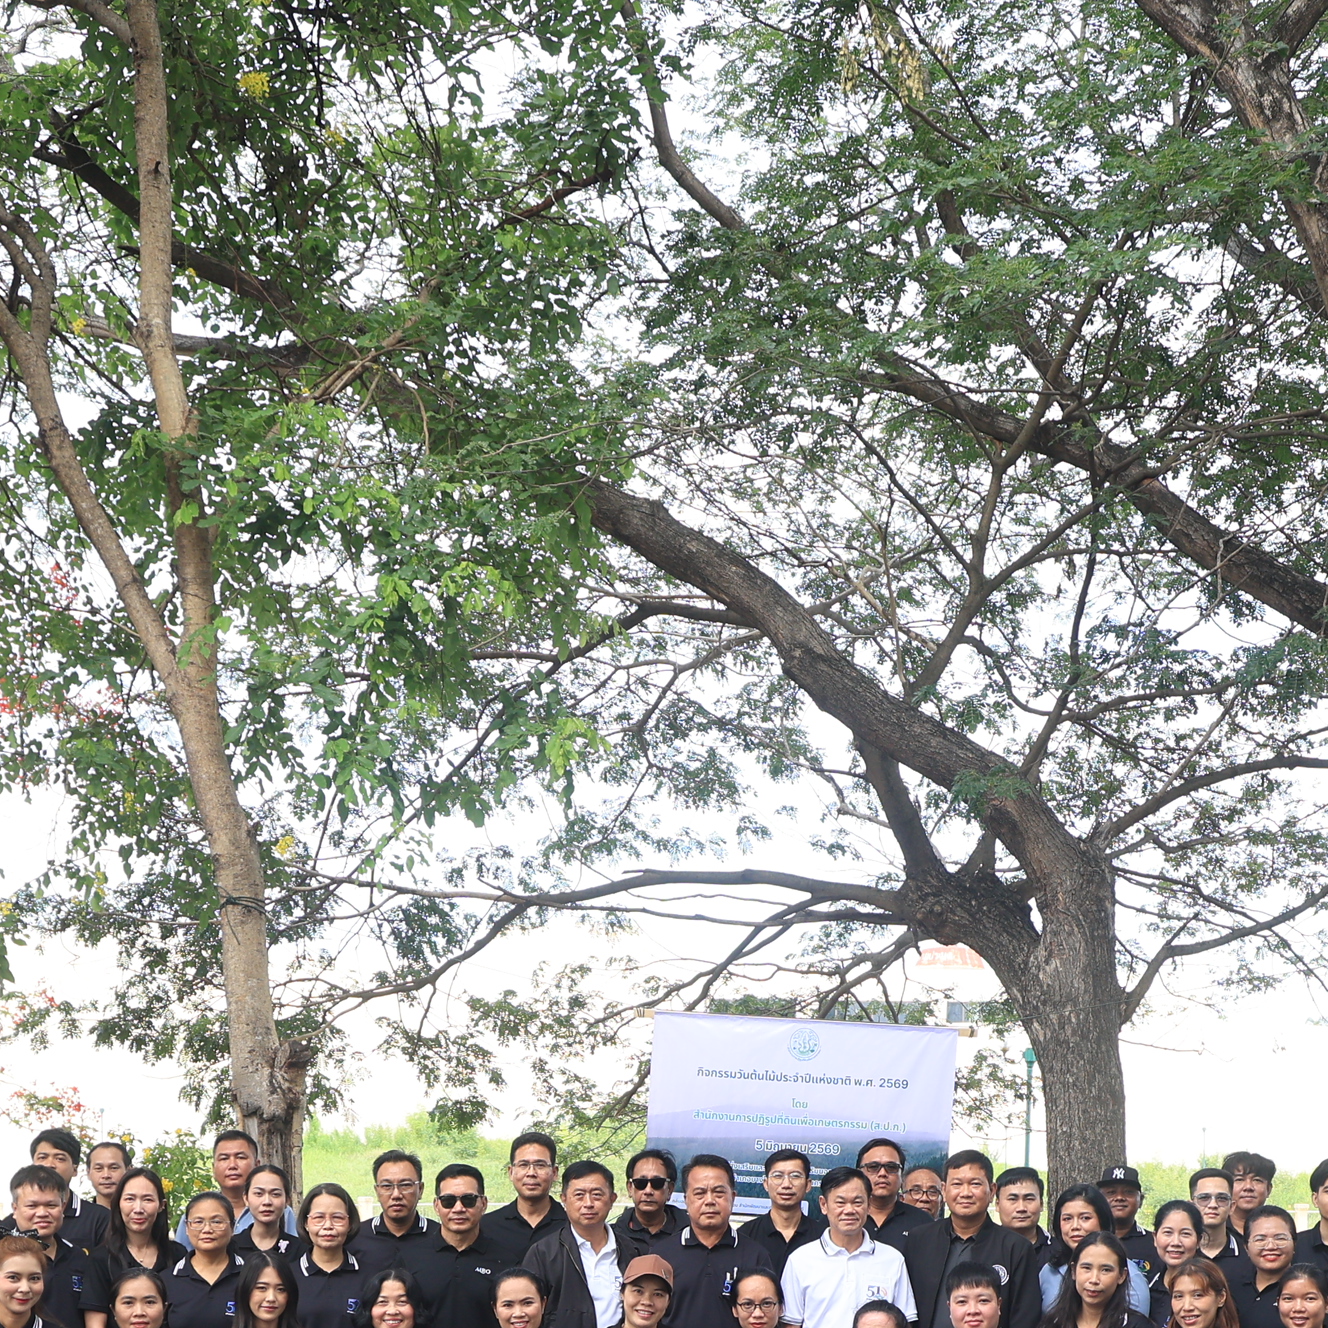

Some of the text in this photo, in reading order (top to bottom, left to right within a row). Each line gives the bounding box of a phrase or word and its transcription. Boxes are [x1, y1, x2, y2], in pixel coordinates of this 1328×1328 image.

[696, 1066, 909, 1090] กิจกรรมวันต้นไม้ประจำปีแห่งชาติ พ.ศ. 2569
[791, 1098, 808, 1109] โดย
[693, 1109, 906, 1134] สำนักงานการปฏิรูปที่ดินเพื่อเกษตรกรรม (ส.ป.ก.)
[755, 1139, 763, 1151] 5
[808, 1142, 841, 1155] 2569
